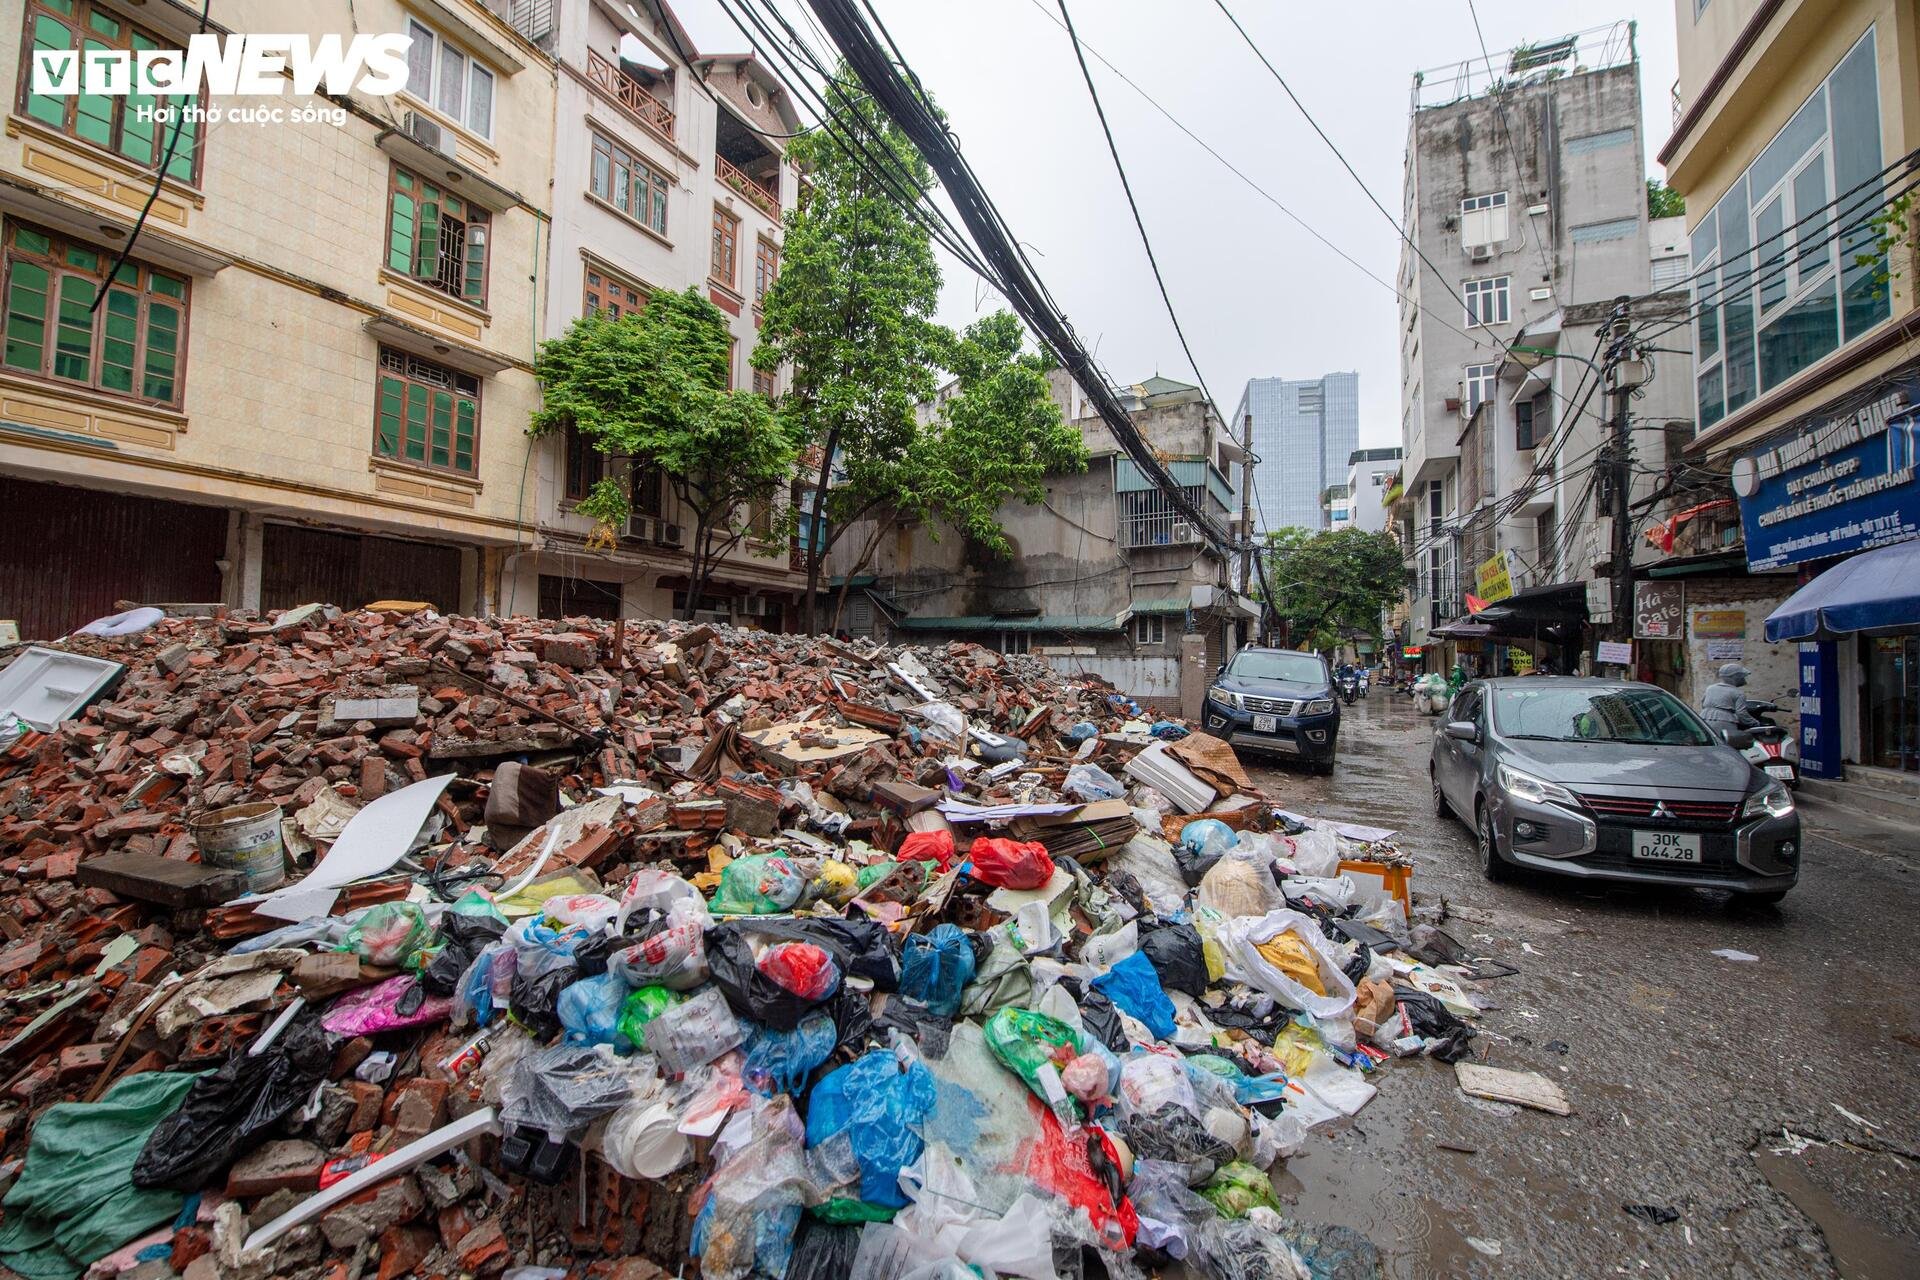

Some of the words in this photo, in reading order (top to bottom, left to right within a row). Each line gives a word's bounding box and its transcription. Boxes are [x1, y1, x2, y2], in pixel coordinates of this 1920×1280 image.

[1835, 458, 1858, 477] GPP
[1639, 592, 1662, 612] Hà
[1637, 604, 1680, 624] Café
[250, 829, 275, 843] TOA
[1653, 834, 1680, 846] 30K
[1641, 846, 1693, 860] 044.28
